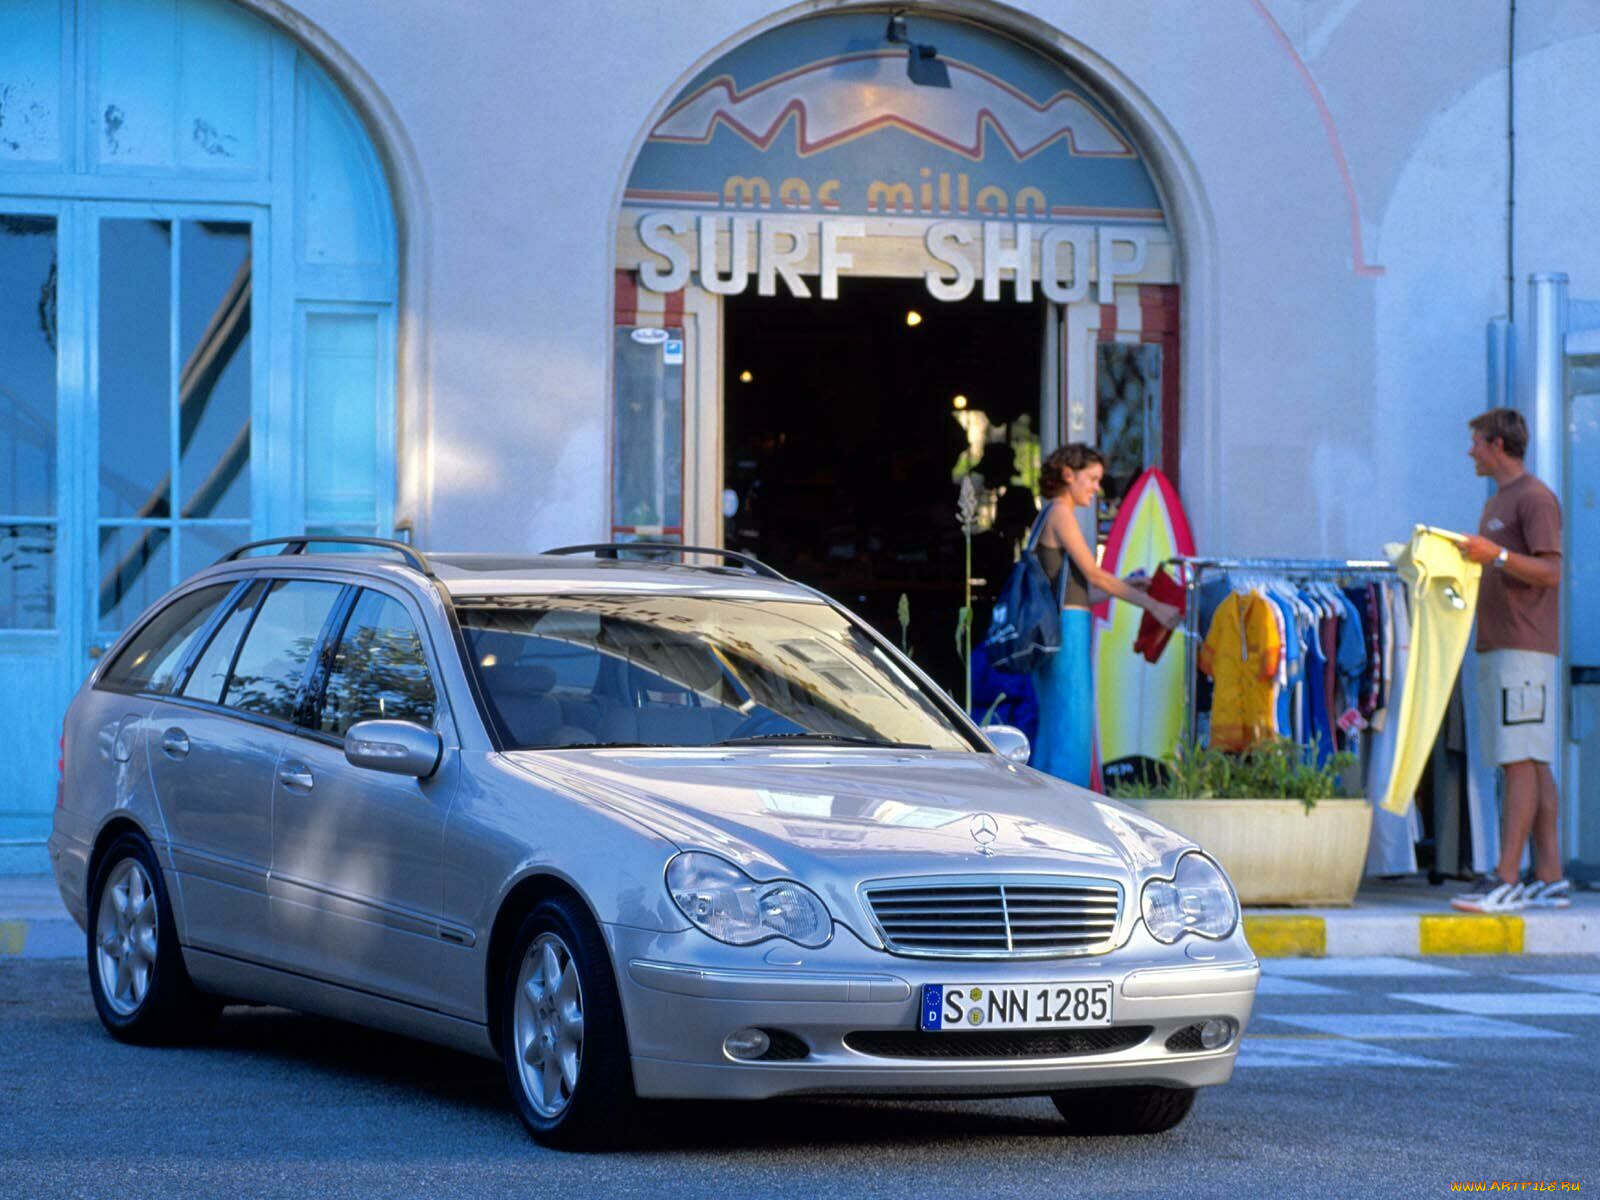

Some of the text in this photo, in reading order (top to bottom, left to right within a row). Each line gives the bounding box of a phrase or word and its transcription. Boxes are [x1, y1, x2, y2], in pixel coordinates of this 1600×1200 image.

[724, 168, 1046, 218] mac millan
[638, 212, 1148, 304] SURF SHOP
[929, 1012, 937, 1021] D
[944, 990, 963, 1023] S
[1035, 988, 1107, 1022] 1285
